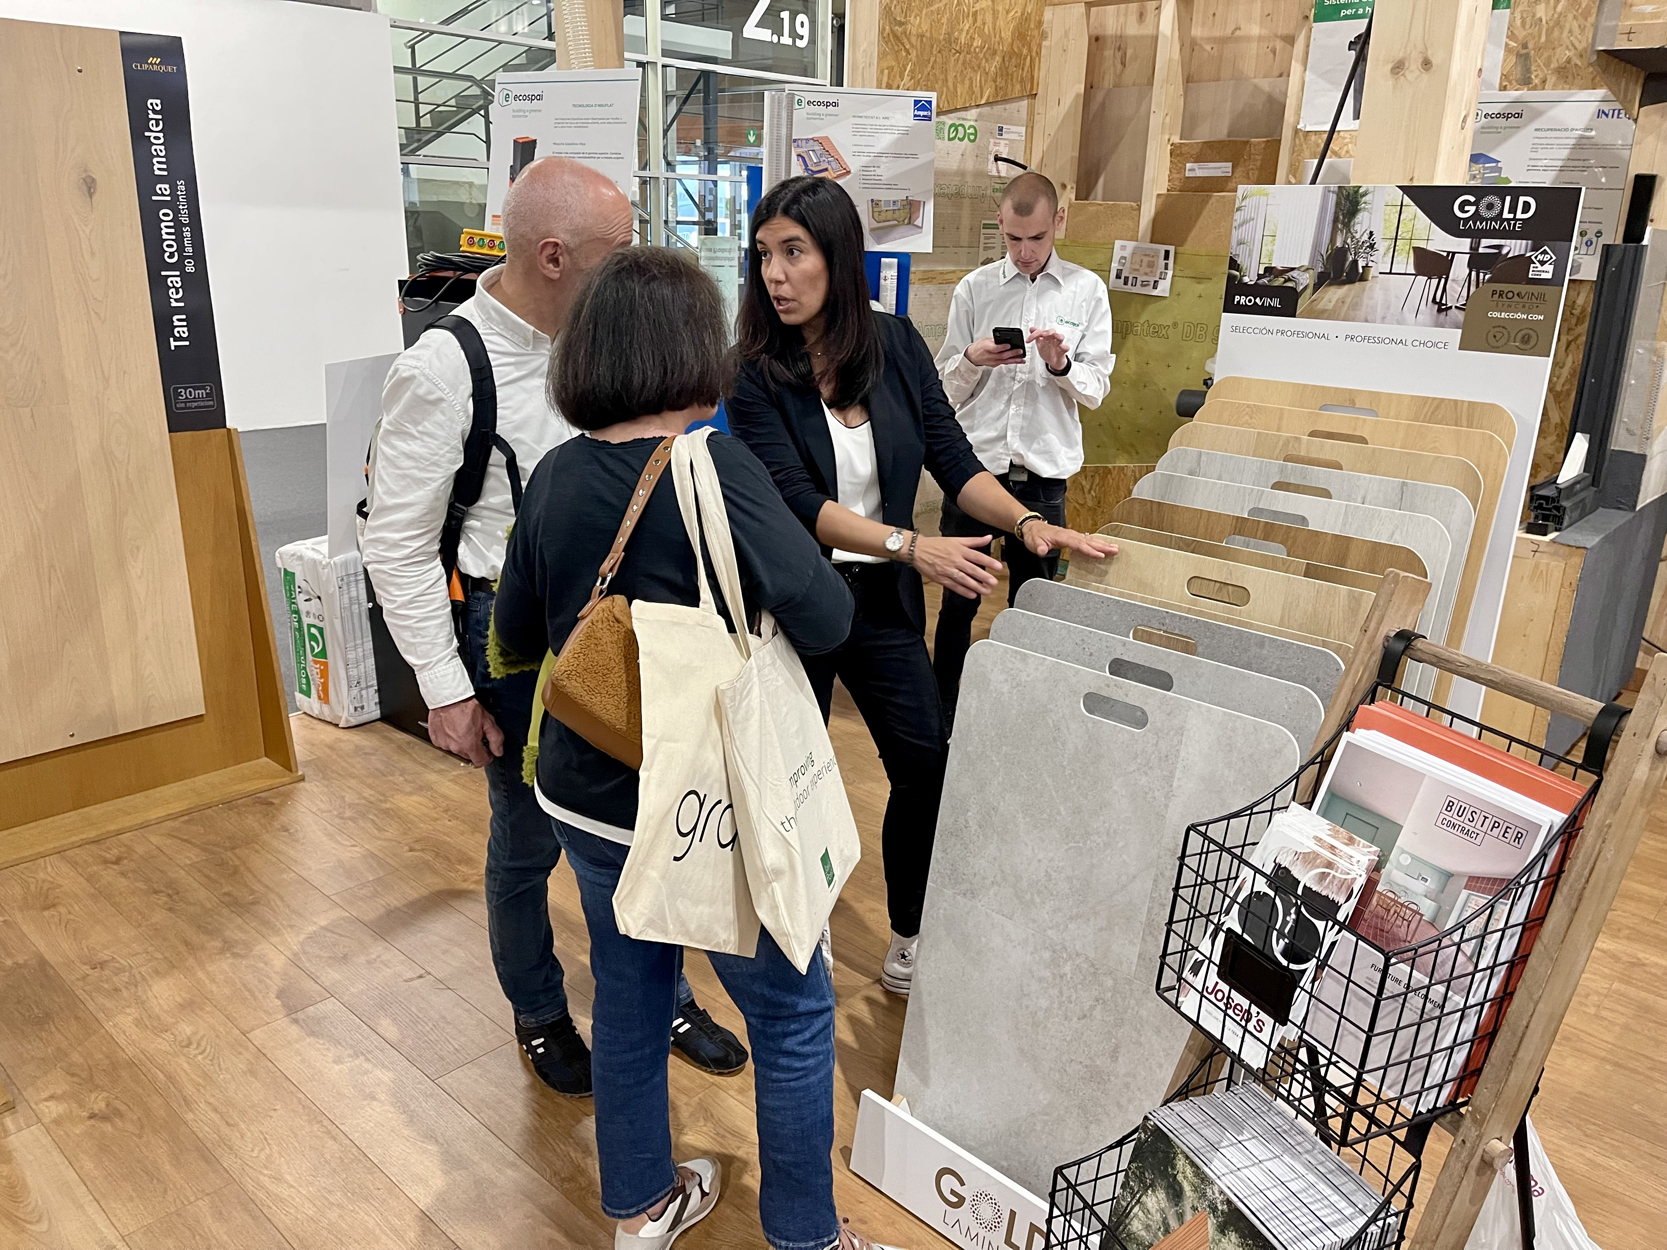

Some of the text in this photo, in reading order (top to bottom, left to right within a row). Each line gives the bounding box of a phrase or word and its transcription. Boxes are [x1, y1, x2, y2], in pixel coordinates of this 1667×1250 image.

[1340, 8, 1355, 17] per
[1365, 6, 1373, 14] h
[132, 63, 178, 73] CLIPARQUET
[513, 91, 544, 103] ecospai
[806, 99, 840, 109] ecospai
[1483, 109, 1524, 121] ecospai
[947, 122, 978, 144] eco
[1453, 194, 1537, 219] GOLD
[144, 98, 190, 350] Tan real como la madera
[176, 179, 196, 273] 80 lamas distintas
[1459, 219, 1523, 231] LAMINATE
[1487, 311, 1527, 320] COLECCIÓN
[917, 320, 948, 341] Ampa
[1181, 321, 1208, 343] DB
[1211, 325, 1220, 345] 9
[1230, 325, 1449, 350] SELECCIÓN PROFESIONAL PROFESSIONAL CHOICE
[1530, 541, 1540, 558] 7
[673, 789, 739, 862] gra
[780, 815, 798, 832] th
[1440, 817, 1481, 841] CONTRACT
[1444, 800, 1524, 845] BUSTPER
[1370, 963, 1403, 987] FURTURE
[1205, 980, 1266, 1034] Josep's
[942, 1209, 1000, 1250] LAMIN
